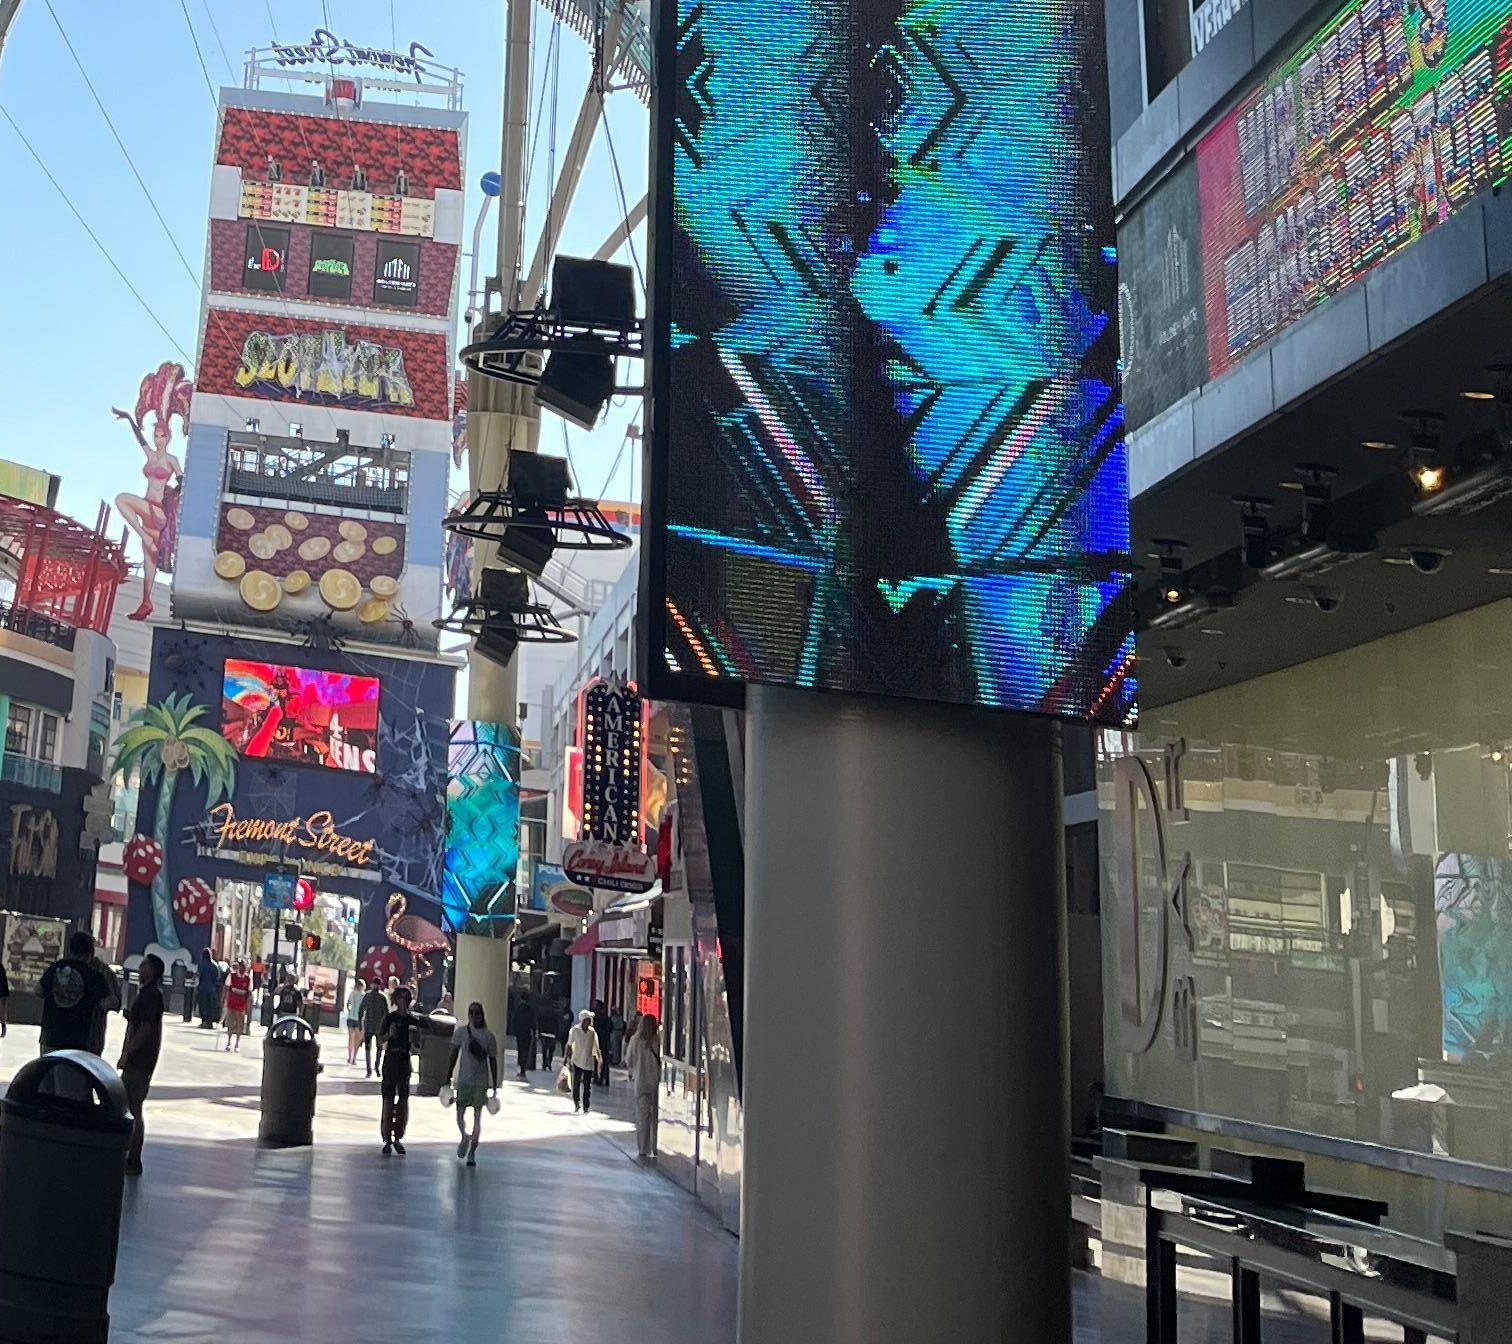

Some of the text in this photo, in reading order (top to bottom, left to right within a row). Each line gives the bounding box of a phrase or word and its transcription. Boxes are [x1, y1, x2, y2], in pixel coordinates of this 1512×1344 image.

[603, 696, 623, 840] AMERICAN
[210, 803, 376, 864] Fremont Street
